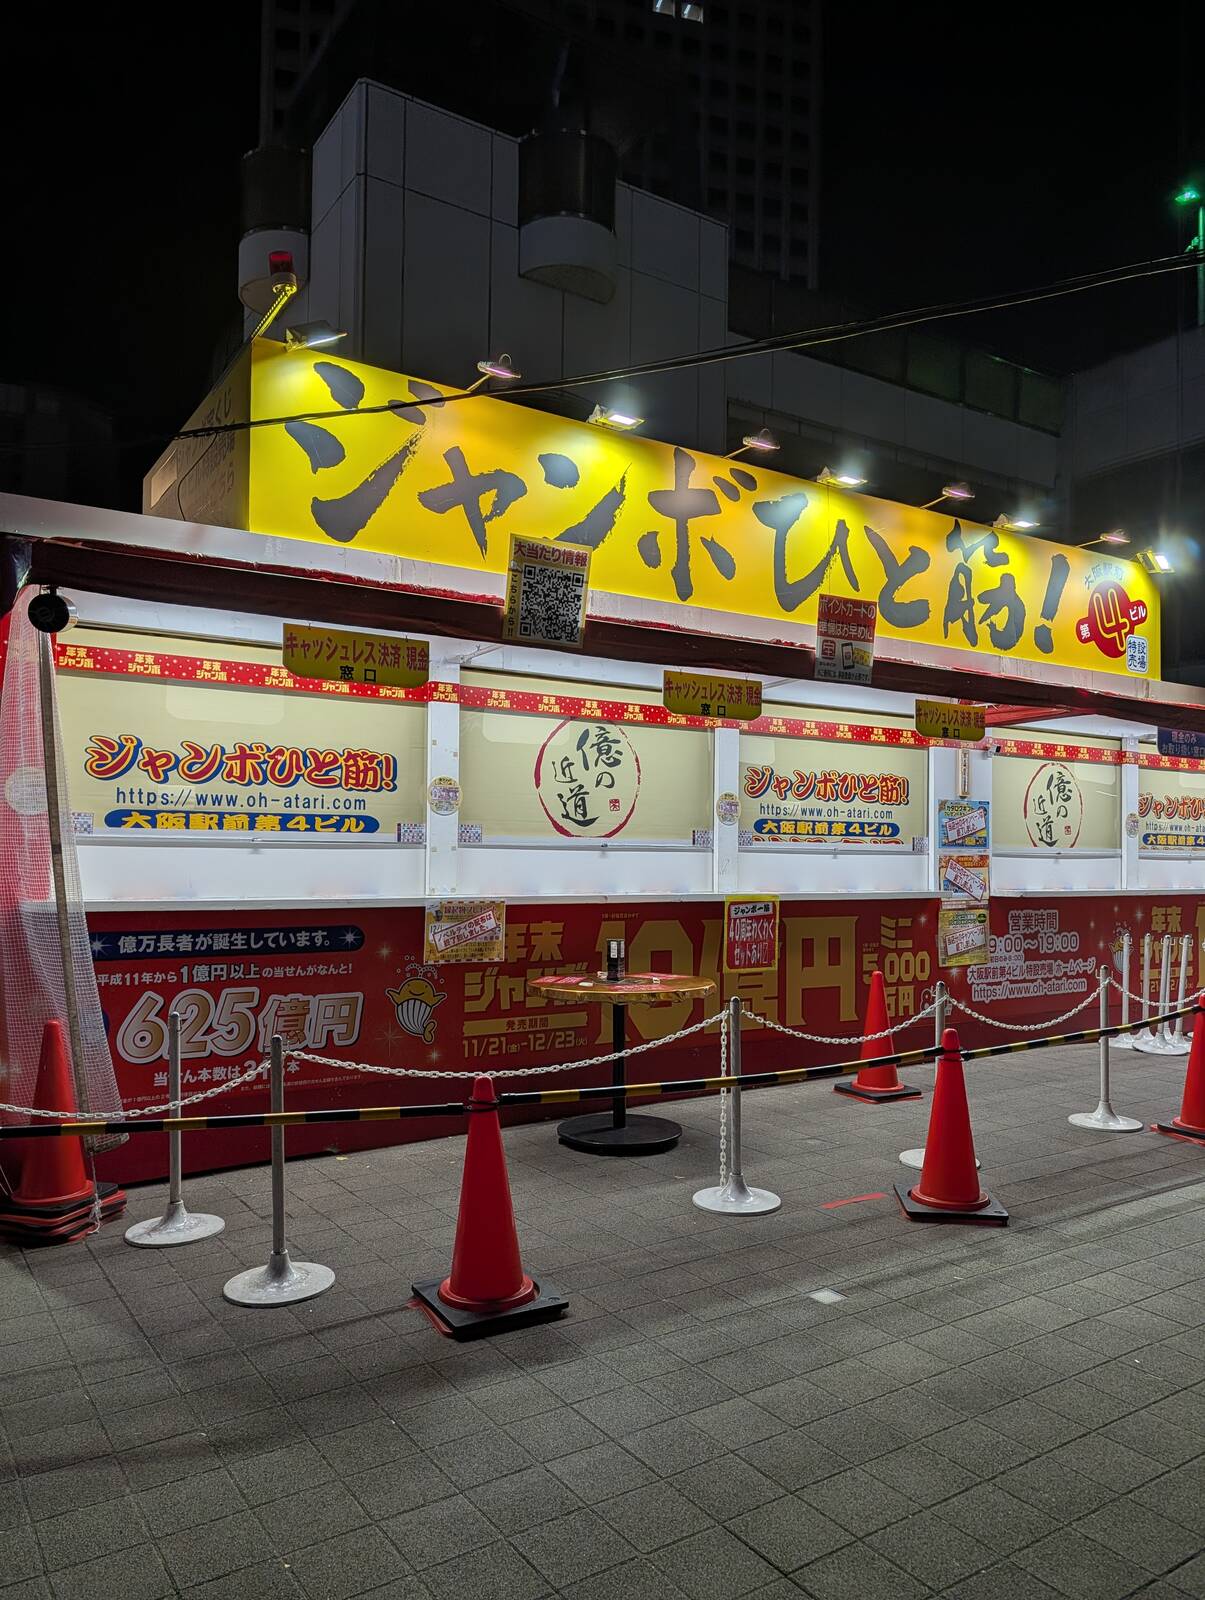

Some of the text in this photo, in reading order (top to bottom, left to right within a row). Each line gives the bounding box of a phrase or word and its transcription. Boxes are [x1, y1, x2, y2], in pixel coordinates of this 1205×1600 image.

[513, 541, 589, 567] 大当たり情報
[819, 597, 876, 619] ポイントカードの
[1129, 604, 1146, 621] ビル
[66, 646, 88, 658] 年末
[134, 653, 155, 665] 年末
[58, 656, 94, 670] ジャンボ
[127, 663, 161, 675] ジャンボ
[202, 660, 222, 672] 年末
[196, 670, 228, 682] ジャンボ
[270, 668, 288, 678] 年末
[340, 665, 376, 682] 窓口
[264, 676, 294, 688] ジャンボ
[322, 682, 350, 694] ジャンボ
[437, 683, 453, 692] 年末
[379, 687, 406, 698] ジャンボ
[432, 691, 458, 702] ジャンボ
[85, 734, 399, 793] ジャンボひと筋!
[744, 765, 909, 805] ジャンボひと筋!
[116, 787, 367, 811] https://www.oh-atari.com
[759, 803, 893, 820] https://www.oh-atari.com
[121, 811, 365, 832] 大阪駅前第4ビル
[762, 820, 893, 836] 大阪駅前第4ビル
[437, 912, 493, 943] ノベルティの配布は
[1010, 911, 1058, 932] 営業時間
[1151, 905, 1182, 933] 年末
[880, 915, 912, 950] ミニ
[119, 930, 332, 954] 億万長者が誕生しています。
[1055, 958, 1095, 975] ホームページ
[974, 980, 1085, 1003] https://www.oh-atari.com
[117, 986, 366, 1064] 625億円
[505, 1019, 549, 1032] 発売期間
